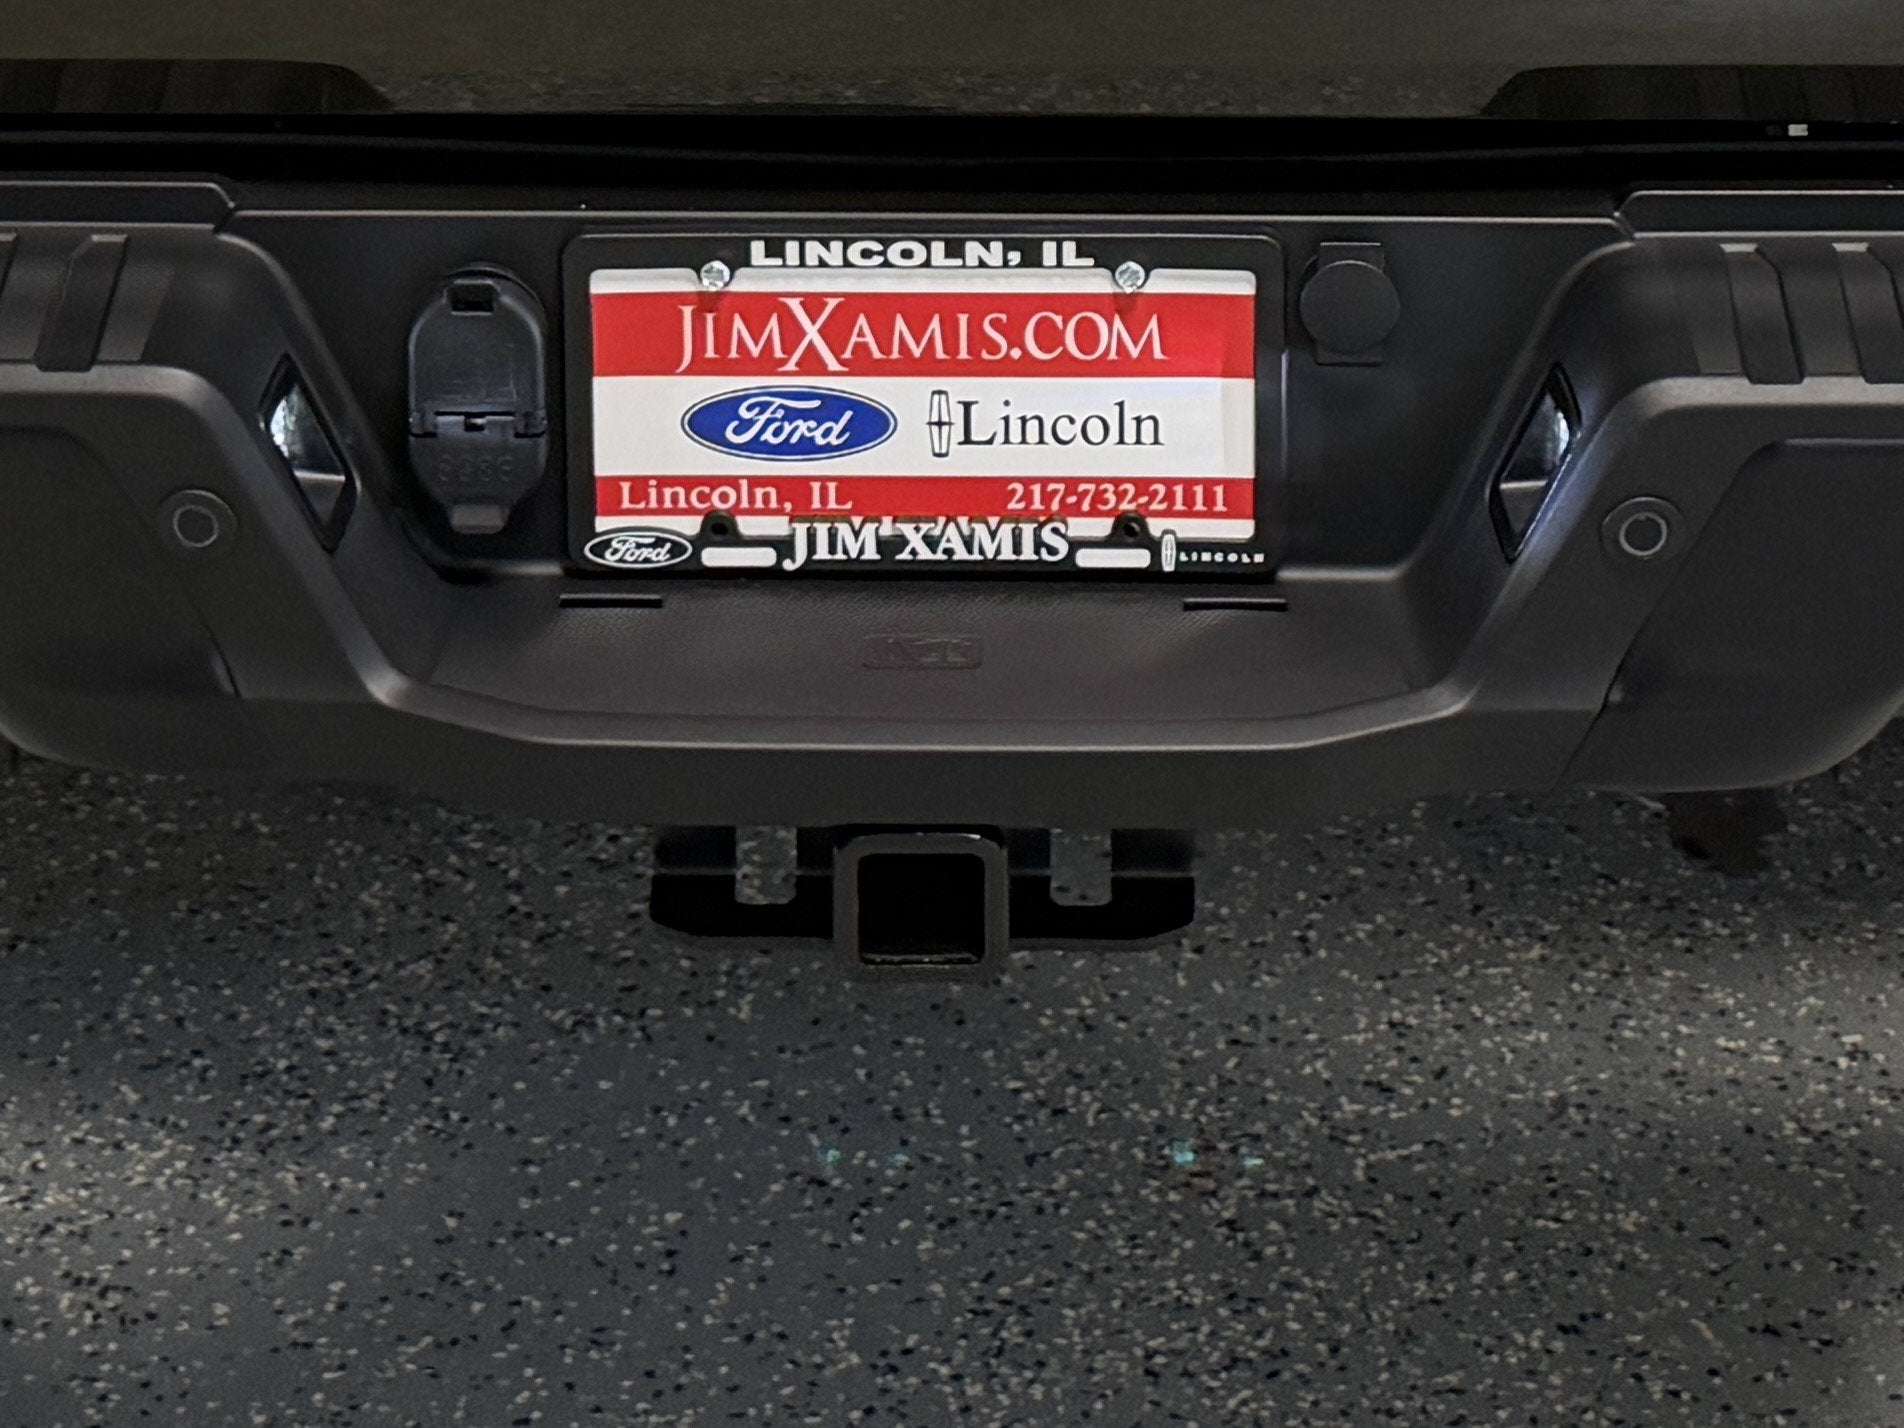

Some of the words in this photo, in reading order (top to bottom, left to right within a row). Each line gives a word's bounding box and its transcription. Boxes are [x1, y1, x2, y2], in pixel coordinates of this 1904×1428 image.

[749, 240, 1023, 268] LINCOLN,
[1042, 240, 1094, 267] IL
[675, 295, 1168, 374] JIMXAMIS.COM
[723, 394, 855, 446] Ford
[956, 399, 1165, 447] Lincoln
[619, 480, 792, 514] Lincoln,
[810, 481, 853, 511] IL
[1006, 482, 1228, 513] 217-732-2111
[604, 536, 672, 562] Ford
[782, 521, 880, 571] JIM
[895, 520, 1069, 562] XAMIS
